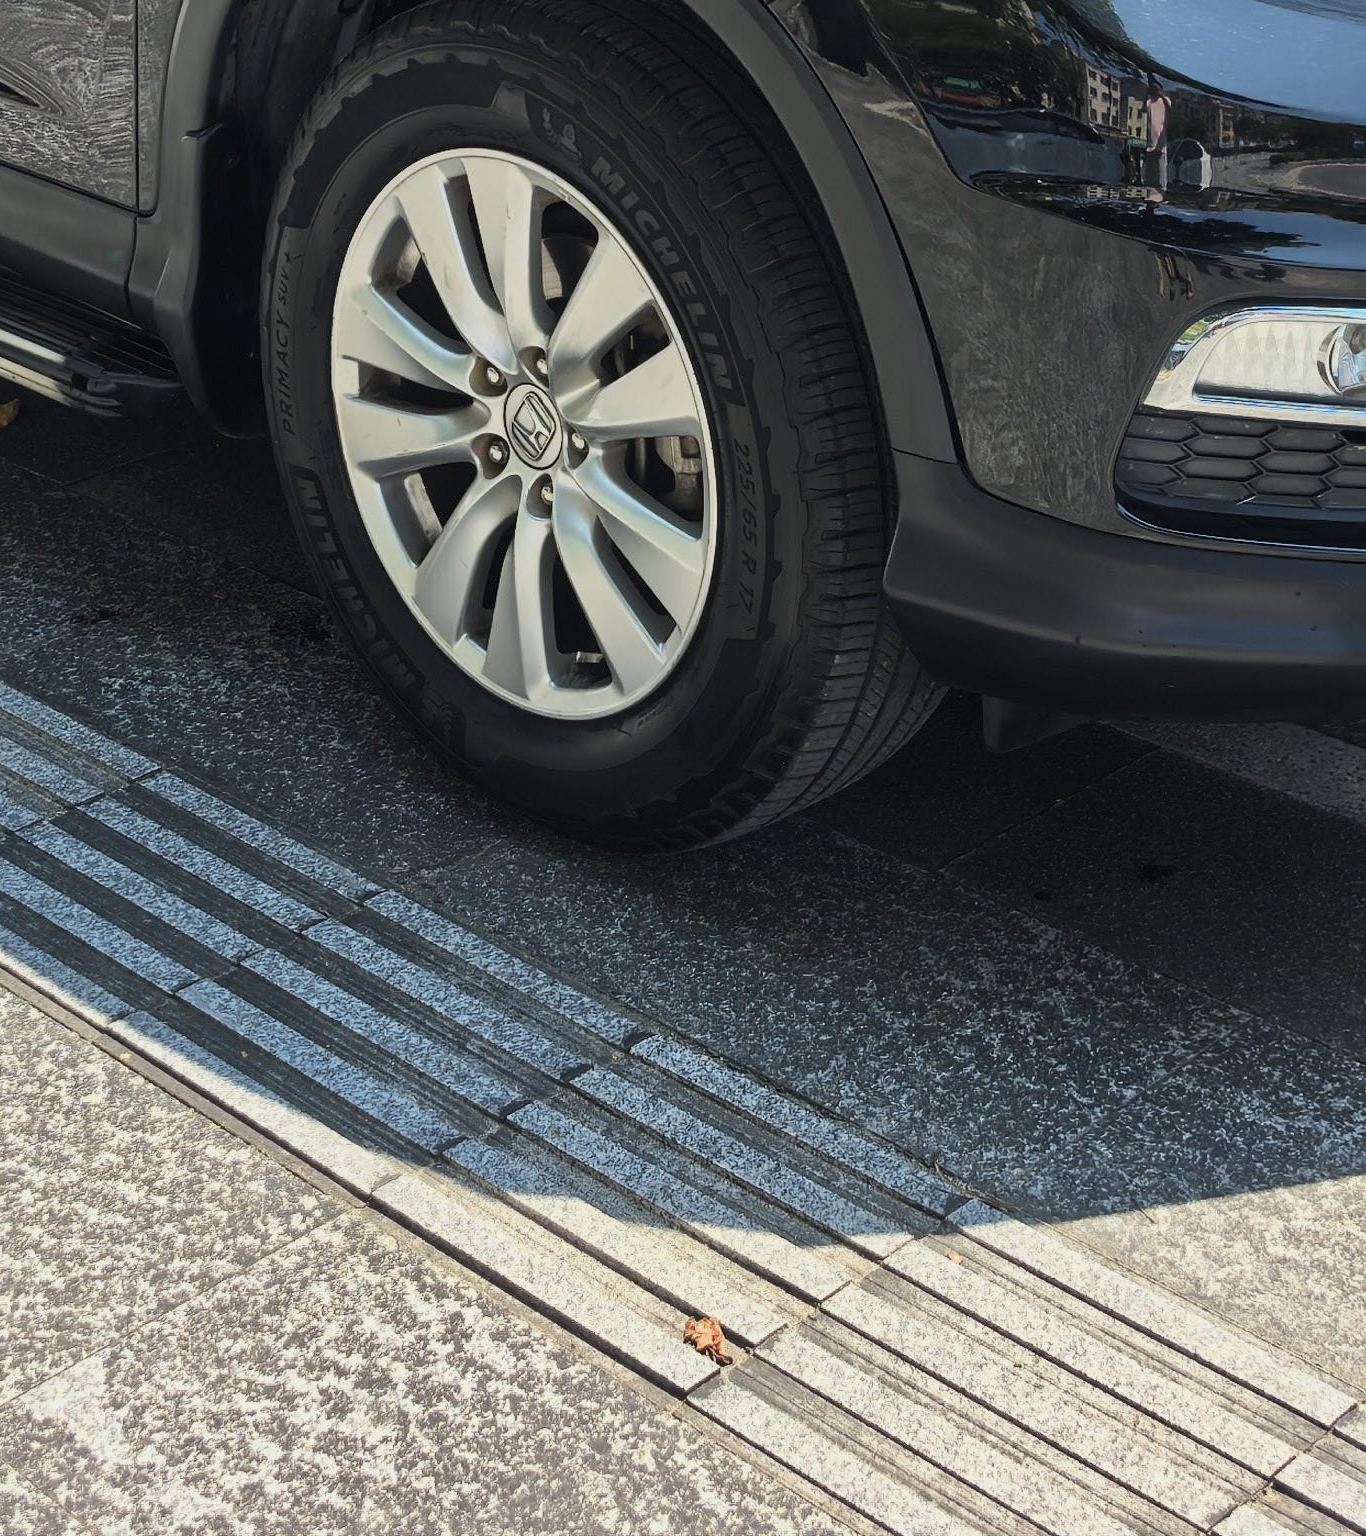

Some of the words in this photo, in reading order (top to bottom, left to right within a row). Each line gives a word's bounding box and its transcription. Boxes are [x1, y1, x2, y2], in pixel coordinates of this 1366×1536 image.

[591, 156, 735, 391] MICHELIN
[273, 313, 297, 437] PRIMACY
[733, 437, 759, 552] 225/65
[738, 582, 756, 616] 17
[741, 550, 758, 575] R
